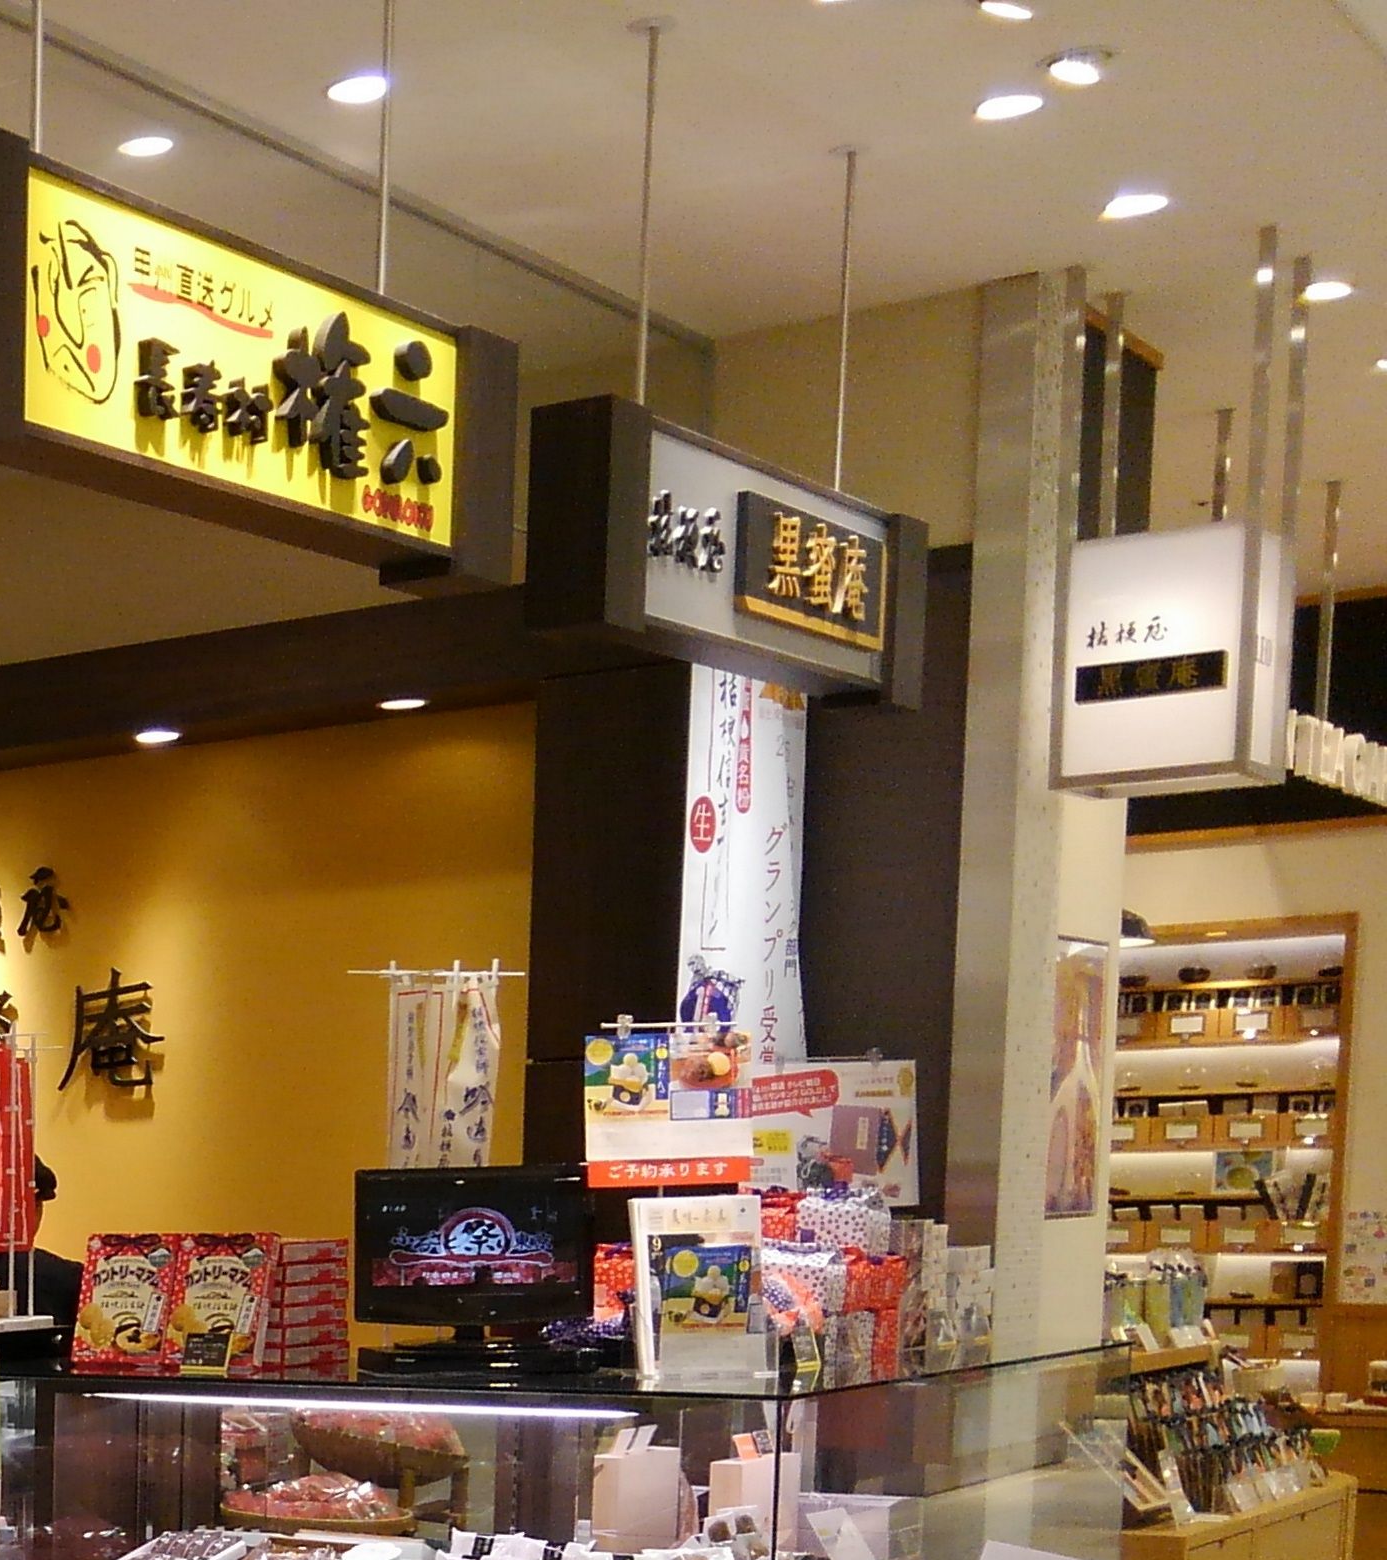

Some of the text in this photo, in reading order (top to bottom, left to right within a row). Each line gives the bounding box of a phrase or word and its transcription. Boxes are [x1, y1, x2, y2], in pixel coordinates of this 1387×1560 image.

[765, 512, 869, 622] 黒蜜庵
[1086, 616, 1169, 650] 桔梗屋
[693, 803, 712, 842] 生
[609, 1162, 727, 1180] ご予約承ります
[92, 1265, 162, 1287] カントリーマアム
[184, 1265, 254, 1288] カントリーマアム
